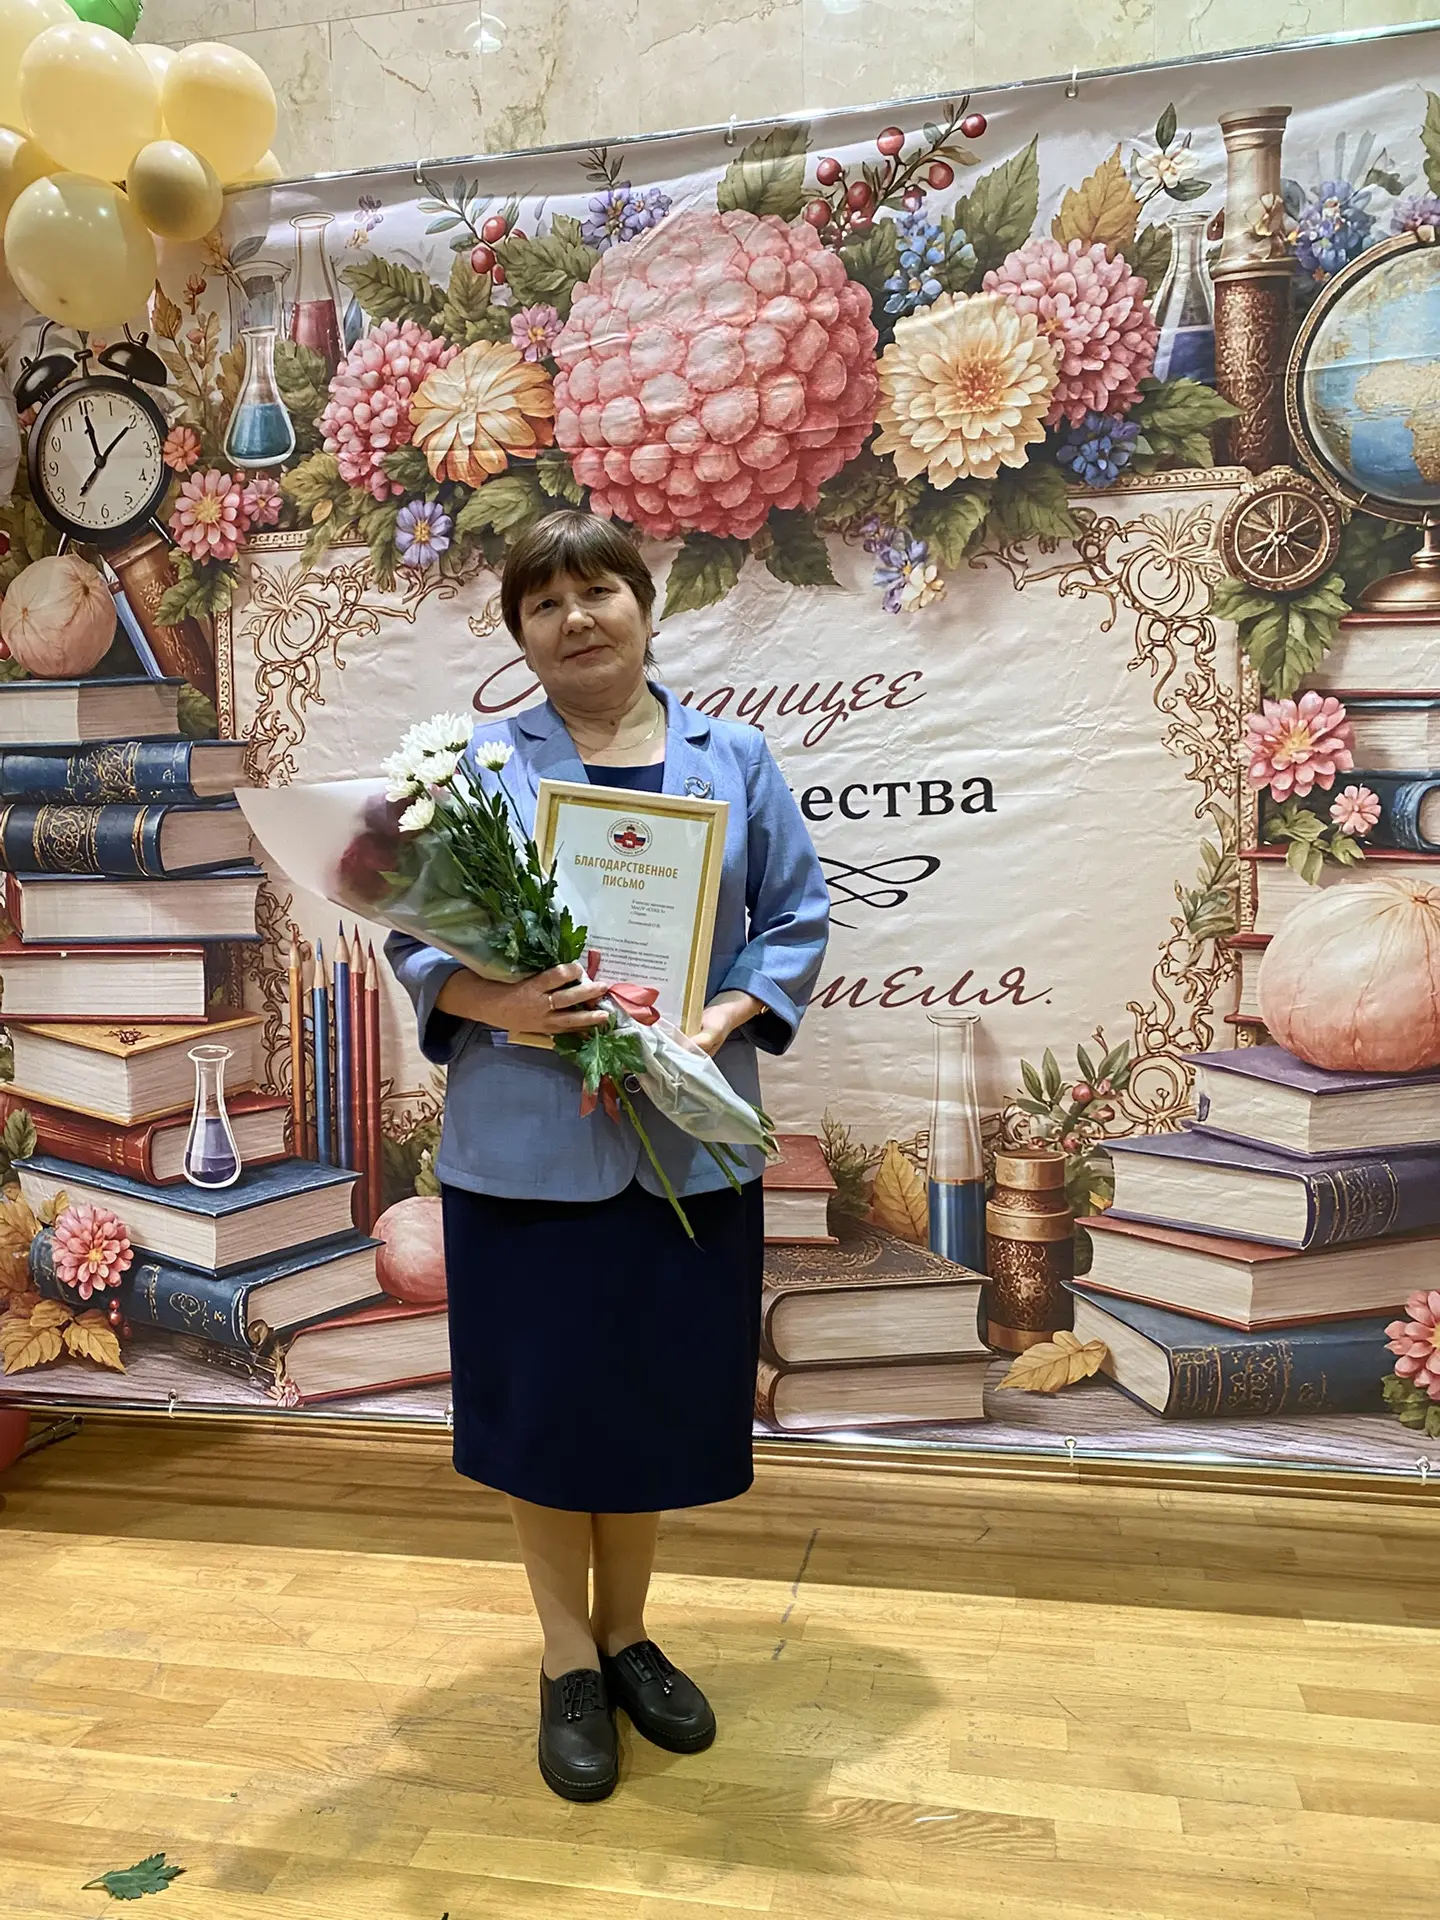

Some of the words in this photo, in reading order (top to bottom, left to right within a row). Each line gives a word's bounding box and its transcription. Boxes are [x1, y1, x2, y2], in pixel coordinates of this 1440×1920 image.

[100, 503, 110, 519] 6
[799, 776, 998, 821] ества
[574, 854, 679, 879] БЛАГОДАРСТВЕННОЕ
[602, 874, 645, 890] ПИСЬМО
[807, 965, 1053, 1009] теля.
